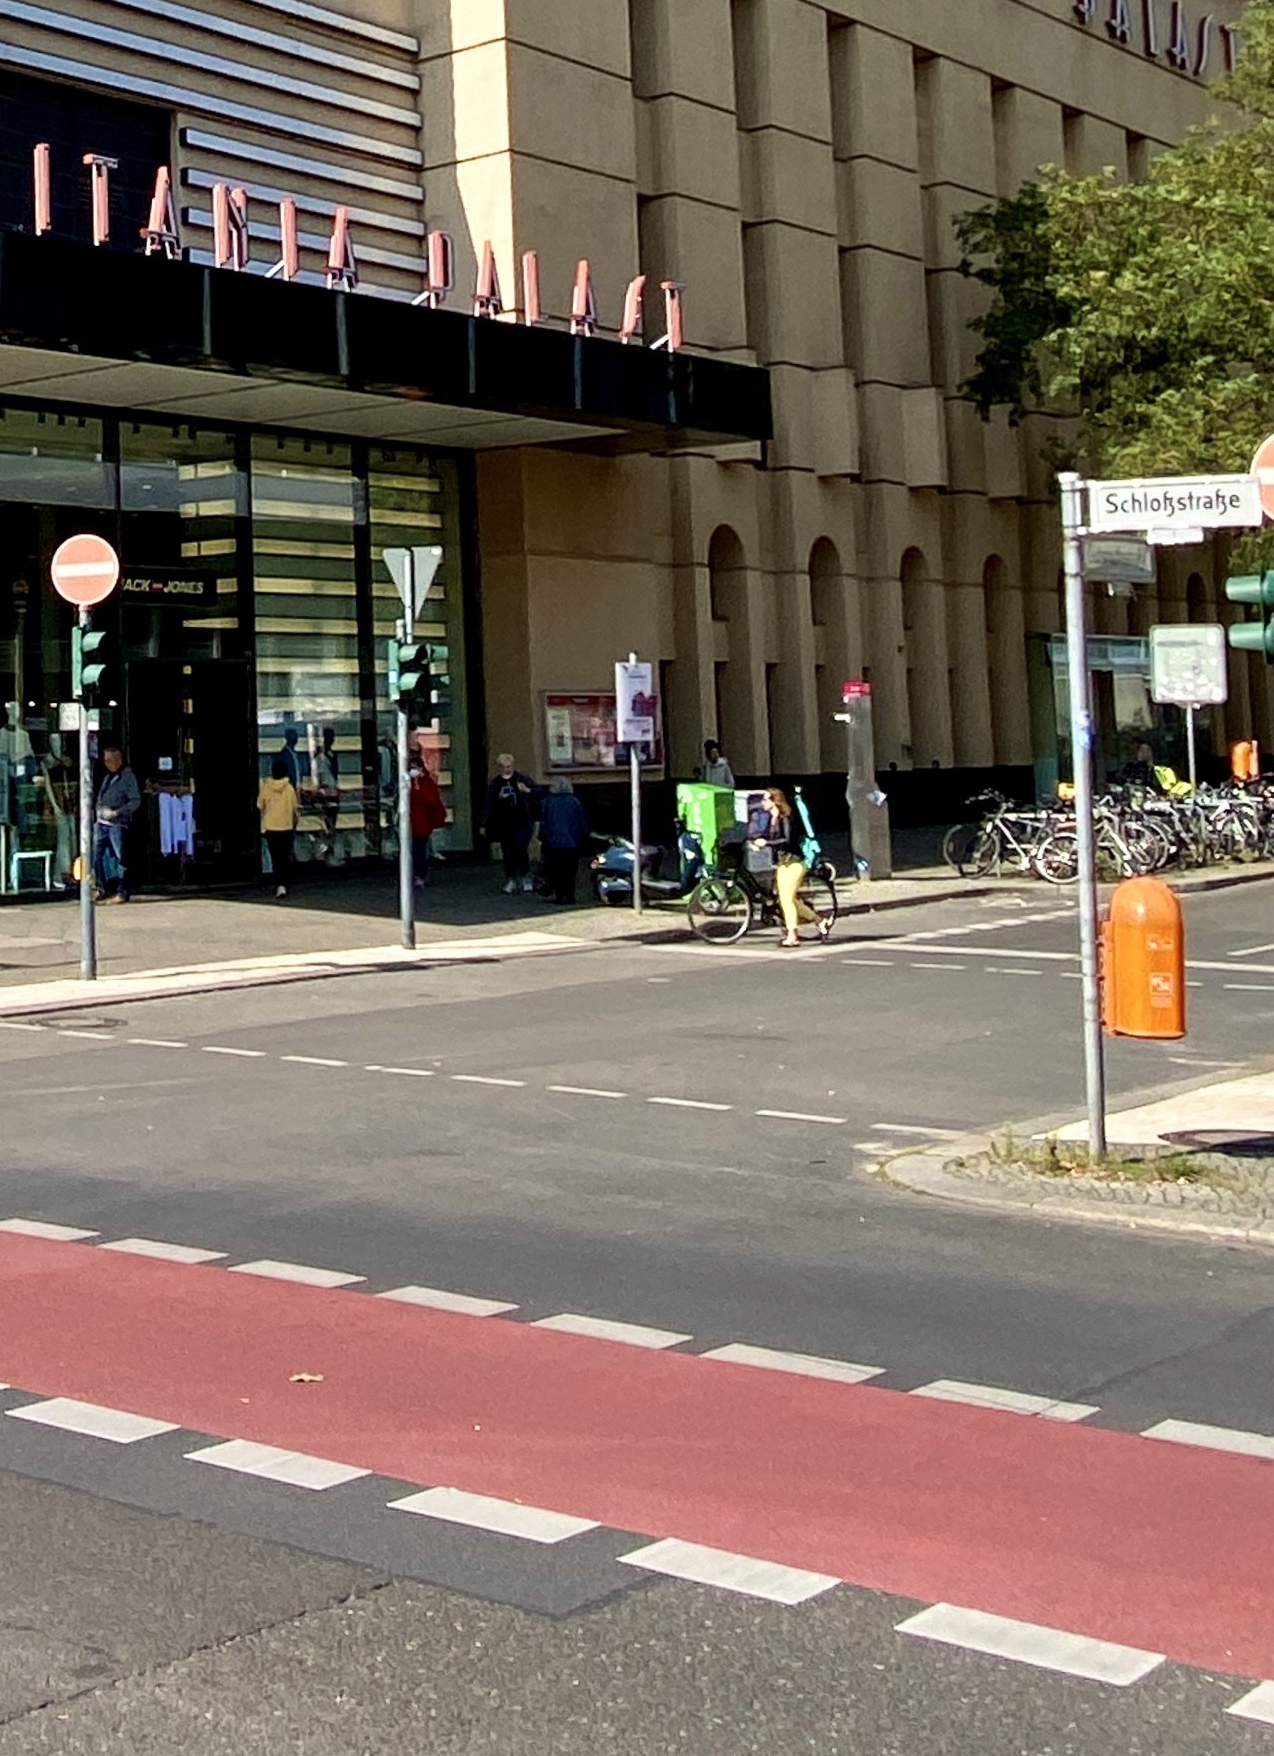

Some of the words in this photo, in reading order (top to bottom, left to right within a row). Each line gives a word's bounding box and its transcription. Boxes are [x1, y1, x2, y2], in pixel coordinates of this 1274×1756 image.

[418, 229, 687, 353] PALAST
[1105, 488, 1241, 518] Schloßstraße
[163, 580, 204, 594] JONES
